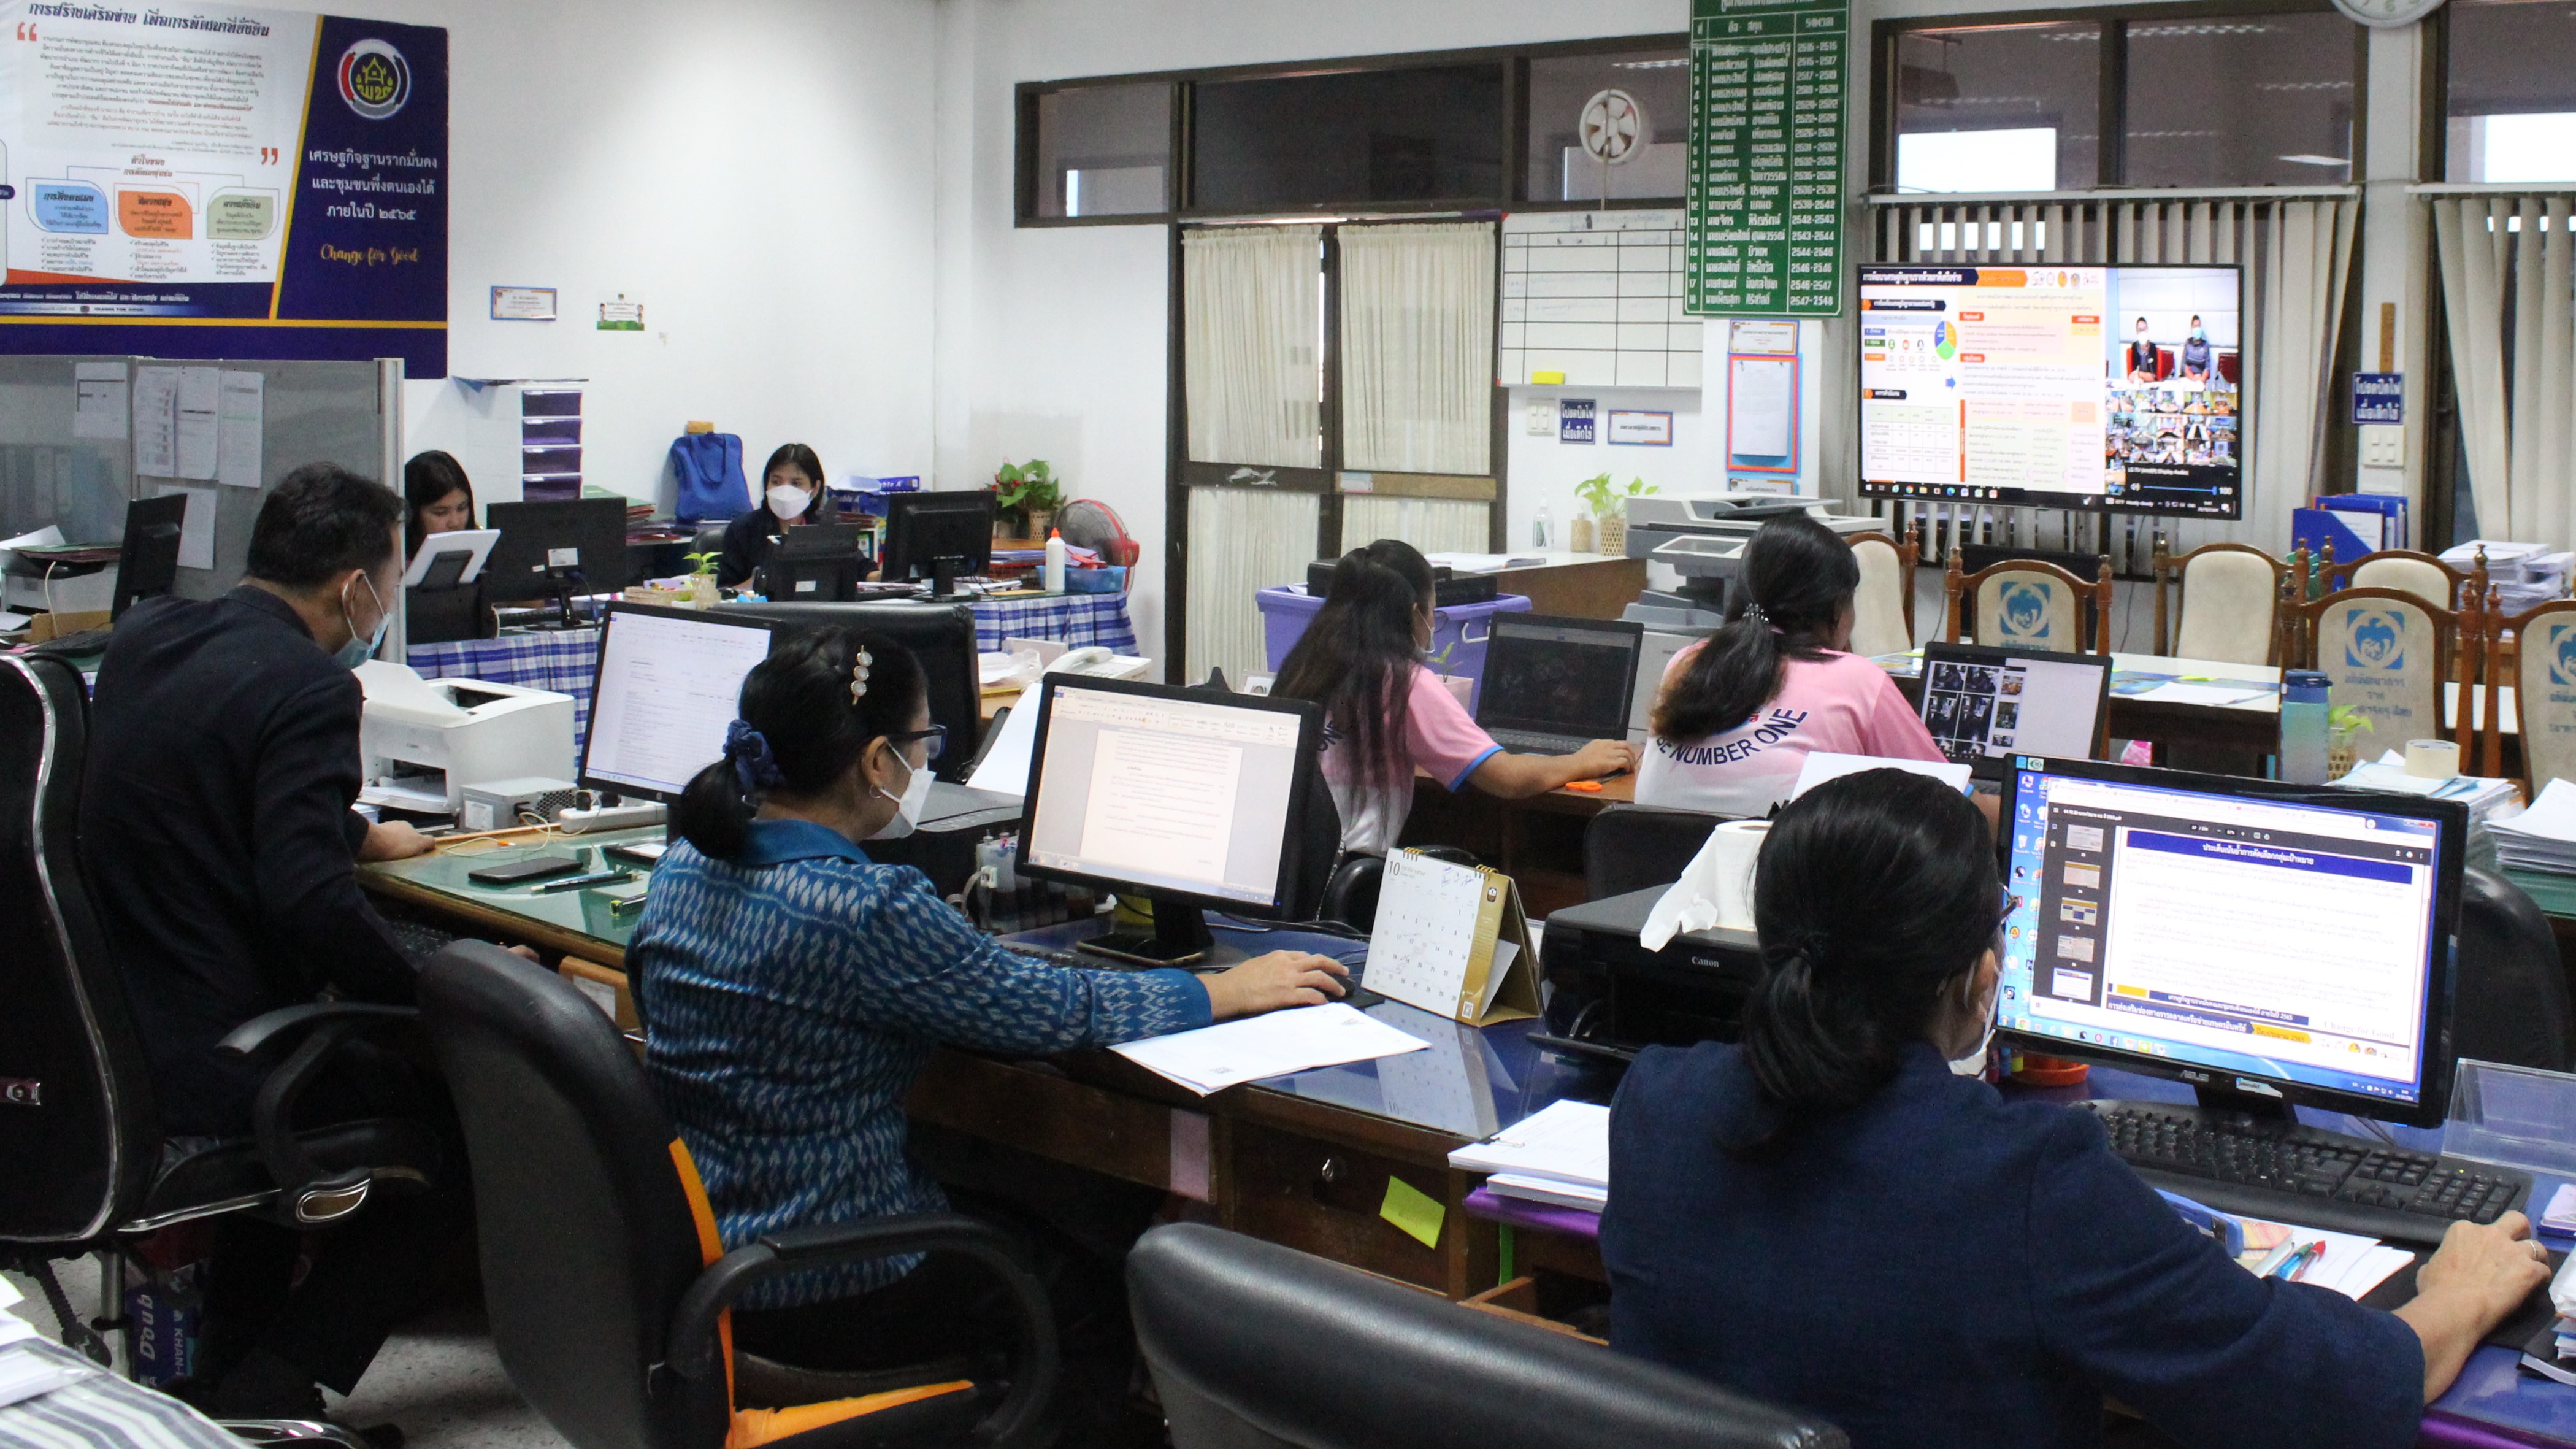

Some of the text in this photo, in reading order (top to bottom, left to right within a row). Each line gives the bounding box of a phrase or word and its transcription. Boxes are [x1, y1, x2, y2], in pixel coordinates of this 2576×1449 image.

[1693, 132, 1698, 140] 7
[309, 148, 437, 169] เศรษฐกิจฐานรากมั่นคง
[1692, 174, 1700, 182] 10
[312, 174, 435, 194] และชุมชนพึ่งตนเองได้
[326, 201, 416, 220] ภายในปี ๒๕๖๕
[1691, 201, 1698, 210] 12
[1690, 217, 1698, 226] 13
[1690, 232, 1698, 240] 14
[320, 244, 419, 266] Change for Good
[1690, 247, 1698, 256] 15
[1690, 263, 1697, 272] 16
[1689, 279, 1696, 288] 17
[1689, 295, 1696, 304] 18
[2219, 486, 2233, 495] 100
[1669, 739, 1761, 765] NUMBER
[1754, 709, 1808, 744] ONE
[1389, 861, 1400, 876] 10
[1692, 956, 1719, 967] Canon
[2324, 1020, 2395, 1040] Change for Good
[2180, 1070, 2209, 1083] ASUS
[137, 1294, 155, 1361] Doub
